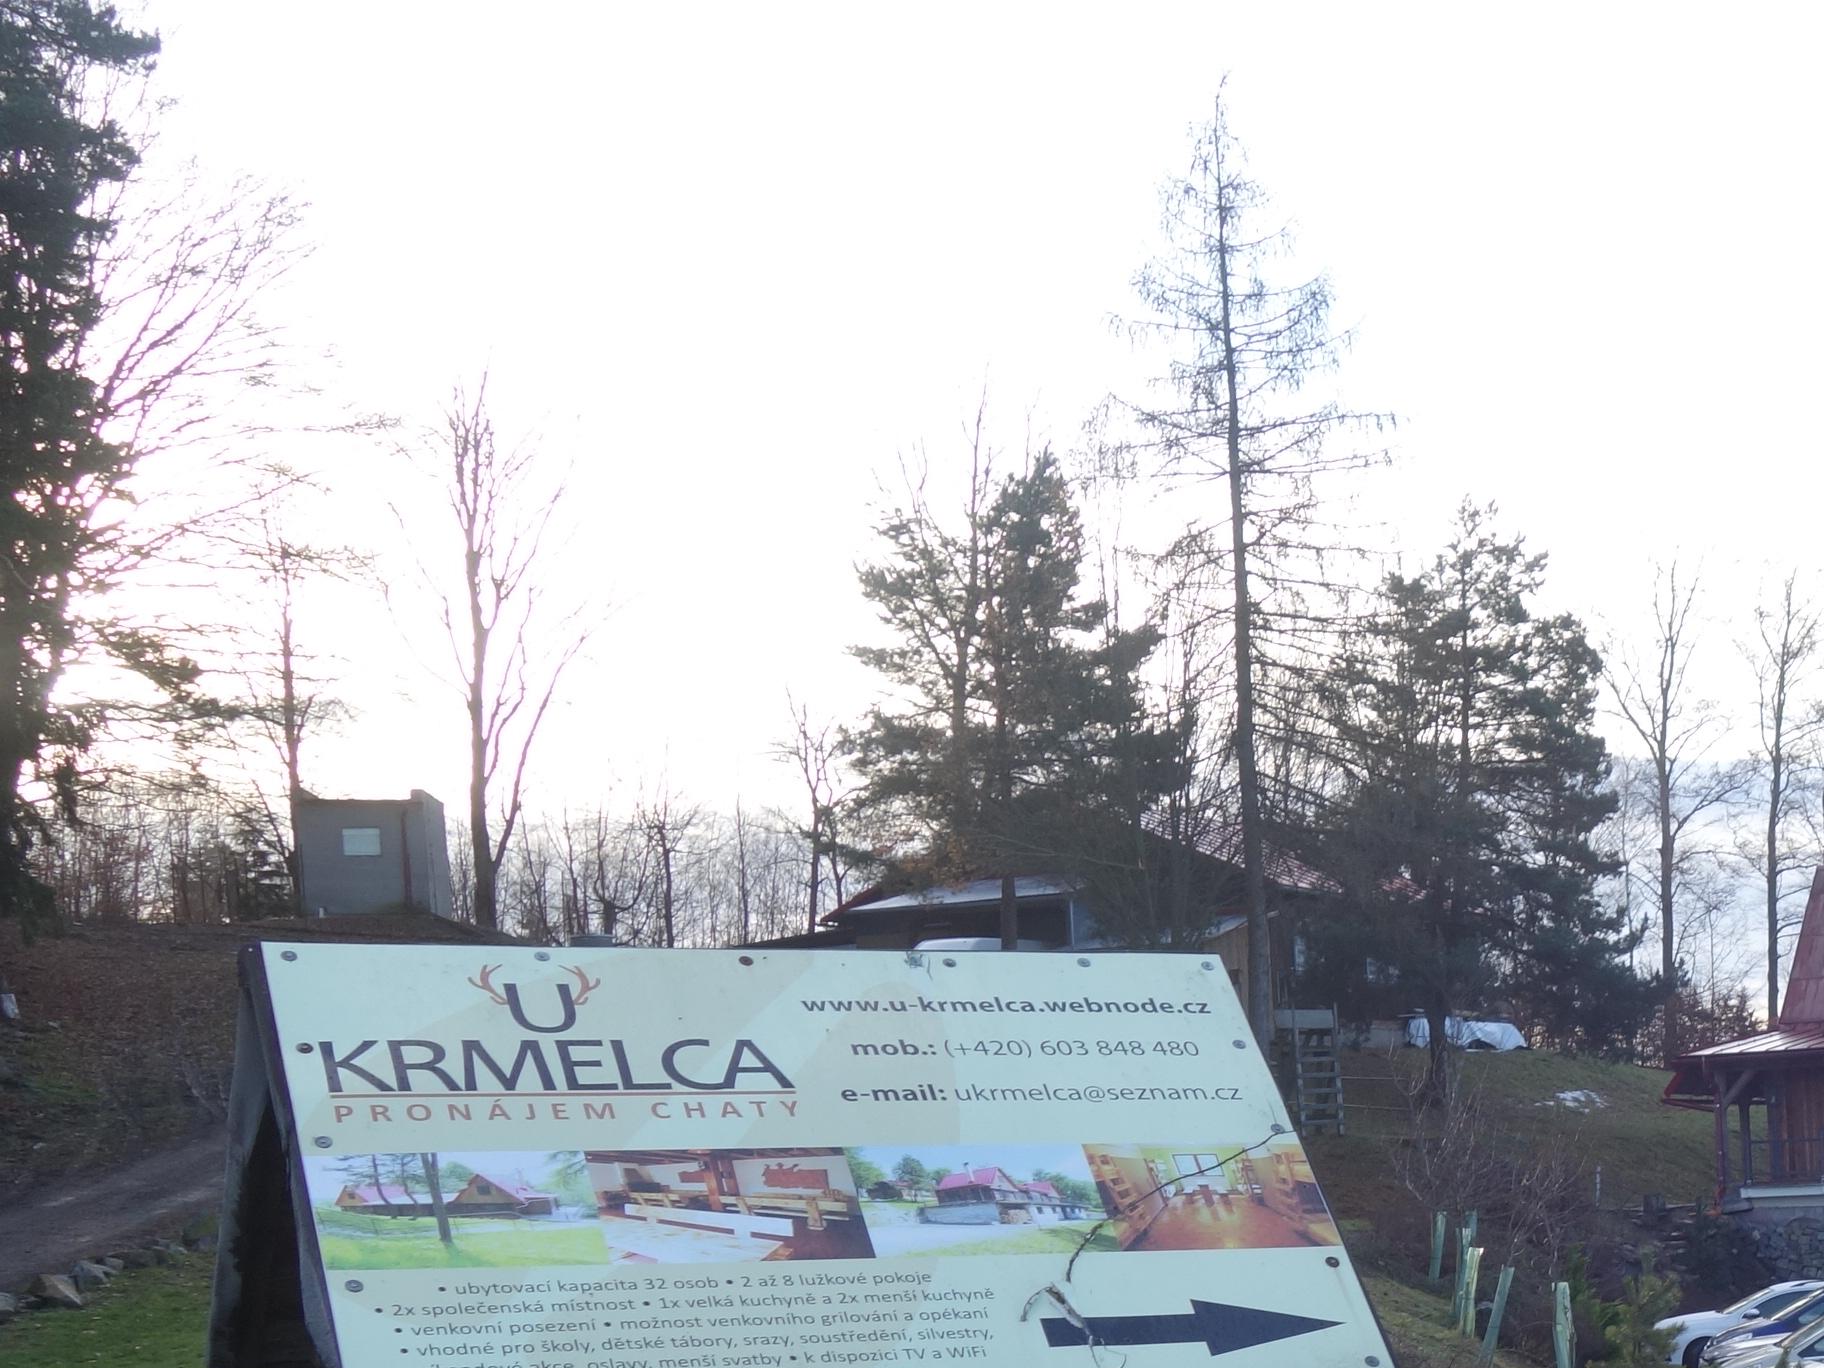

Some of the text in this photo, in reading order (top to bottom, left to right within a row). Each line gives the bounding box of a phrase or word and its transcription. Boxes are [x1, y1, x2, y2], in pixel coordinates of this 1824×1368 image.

[502, 983, 577, 1034] U
[802, 997, 1211, 1015] www.u-krmelca.webnode.cz
[851, 1039, 1199, 1058] mob.: (+420) 603 848 480
[318, 1038, 796, 1092] KRMELCA
[841, 1083, 1243, 1103] e-mail: ukrmelca@seznam.cz
[334, 1098, 798, 1123] PRONÁJEM CHATY
[455, 1281, 551, 1297] ubytovací
[557, 1279, 638, 1295] kapacita
[645, 1278, 666, 1290] 32
[673, 1275, 719, 1289] osob
[741, 1276, 751, 1288] 2
[759, 1275, 777, 1288] až
[783, 1275, 794, 1287] 8
[873, 1271, 932, 1286] pokoje
[392, 1288, 995, 1318] 2x společenská místnost 1x velká kuchyně a 2x menší kuchyně
[411, 1320, 503, 1337] venkovní
[510, 1319, 597, 1336] posezení
[620, 1314, 703, 1329] možnost
[708, 1312, 816, 1328] venkovního
[822, 1310, 898, 1327] grilování
[903, 1312, 913, 1321] a
[417, 1326, 994, 1357] vhodné pro školy, dětské tábory, srazy, soustředění, silvestry,
[659, 1353, 717, 1368] menší
[722, 1353, 782, 1368] svatby
[805, 1351, 816, 1363] k
[821, 1348, 898, 1364] dispozici
[901, 1348, 925, 1360] TV
[932, 1349, 942, 1359] a
[949, 1345, 987, 1358] WiFi
